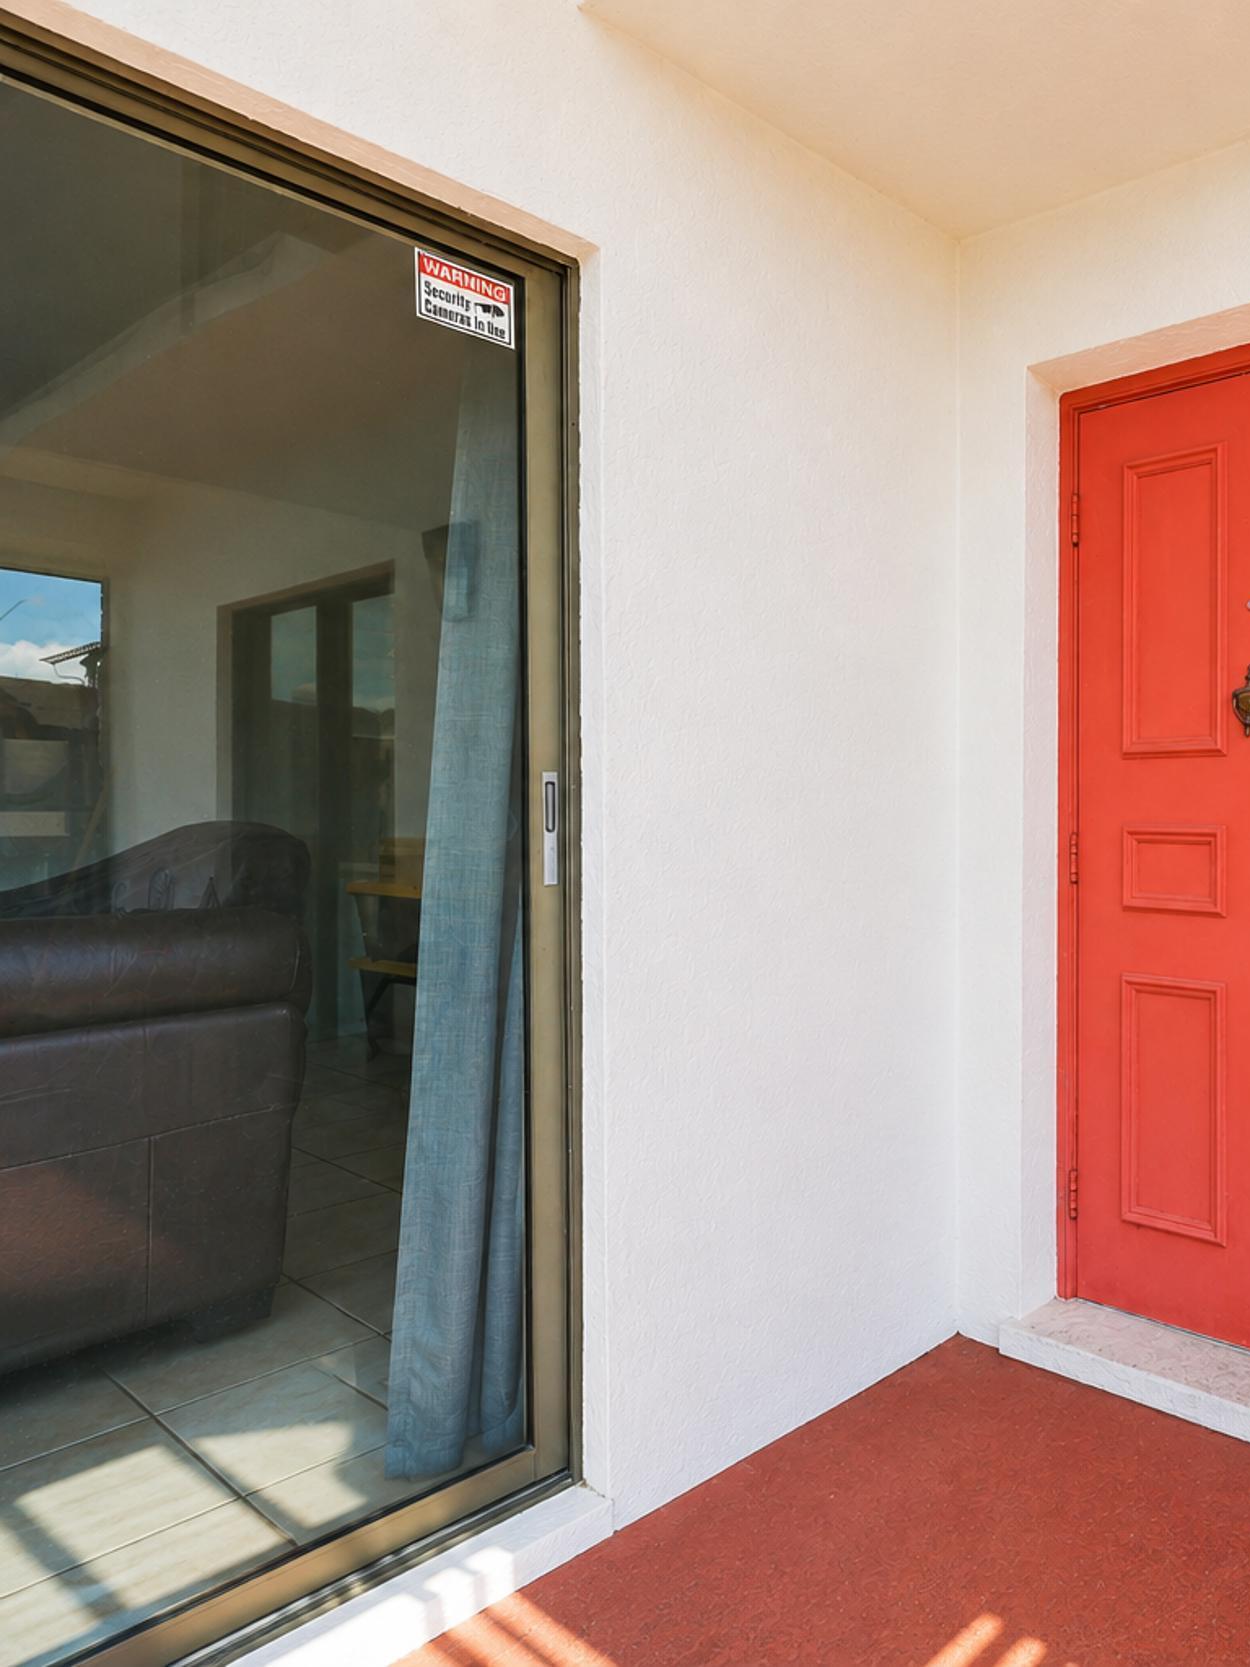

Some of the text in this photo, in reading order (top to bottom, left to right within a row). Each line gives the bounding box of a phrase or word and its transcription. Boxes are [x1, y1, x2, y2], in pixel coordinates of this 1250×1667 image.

[423, 257, 506, 302] WARNING
[424, 281, 471, 312] Security
[424, 299, 471, 327] Cameras
[487, 321, 506, 339] Use
